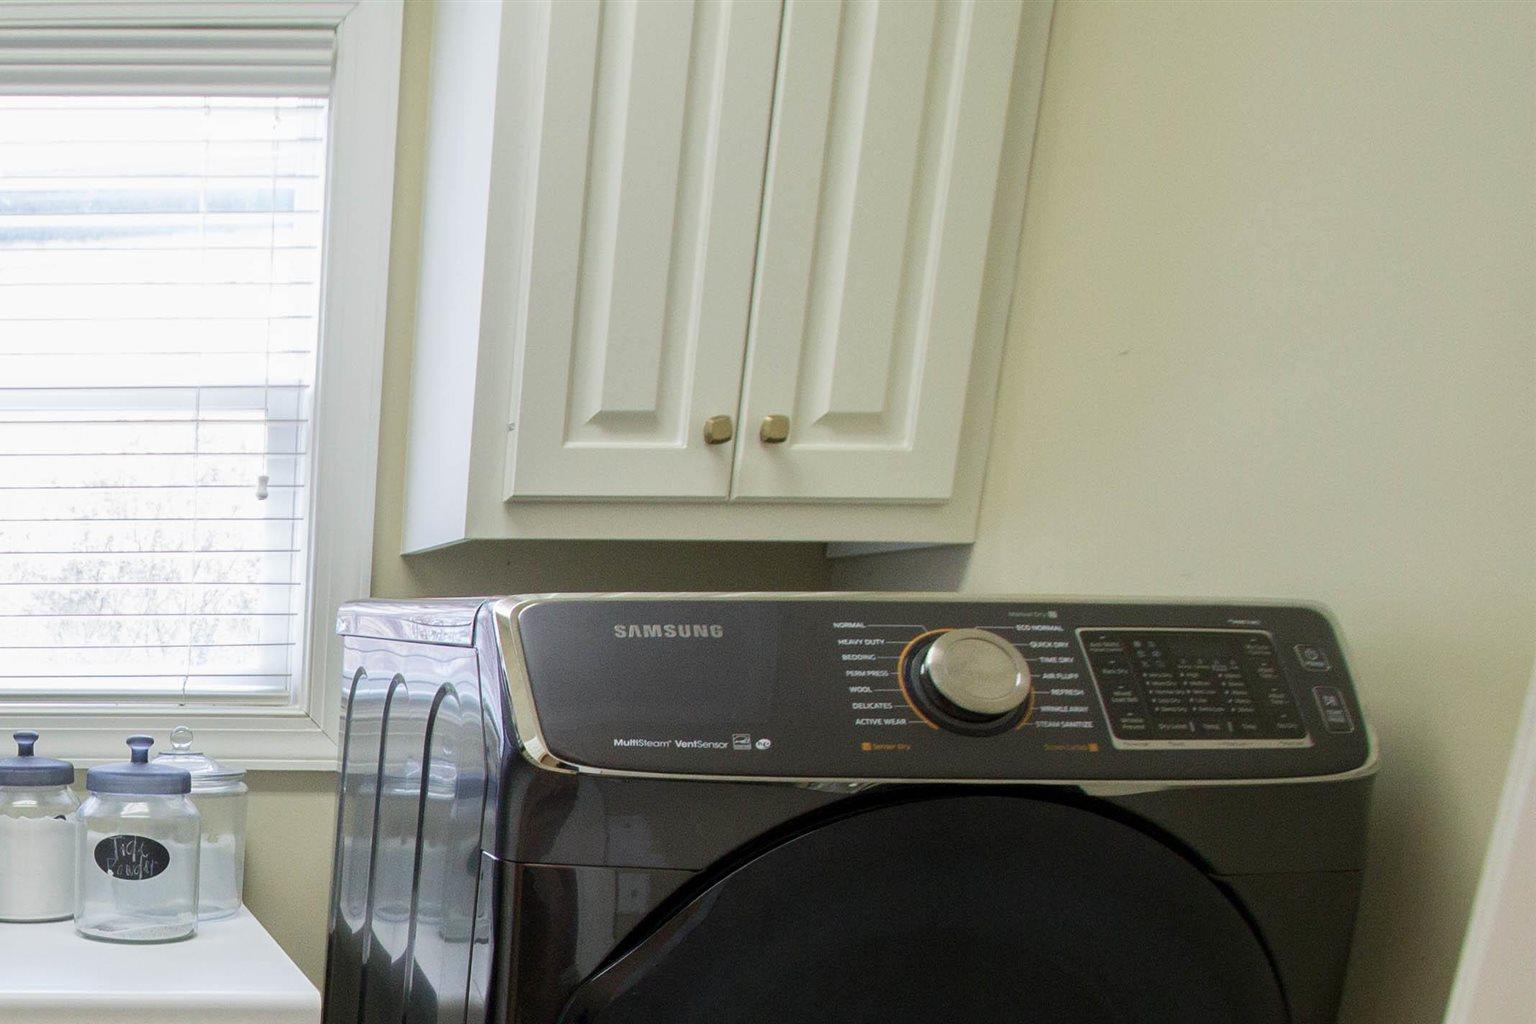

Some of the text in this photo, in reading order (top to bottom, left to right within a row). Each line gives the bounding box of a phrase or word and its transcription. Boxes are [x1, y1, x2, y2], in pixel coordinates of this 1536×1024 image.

[614, 624, 724, 638] SAMSUNG
[1031, 624, 1064, 632] NORMAL
[855, 718, 907, 726] ACTIVE WEAR
[675, 739, 729, 749] VentSensor
